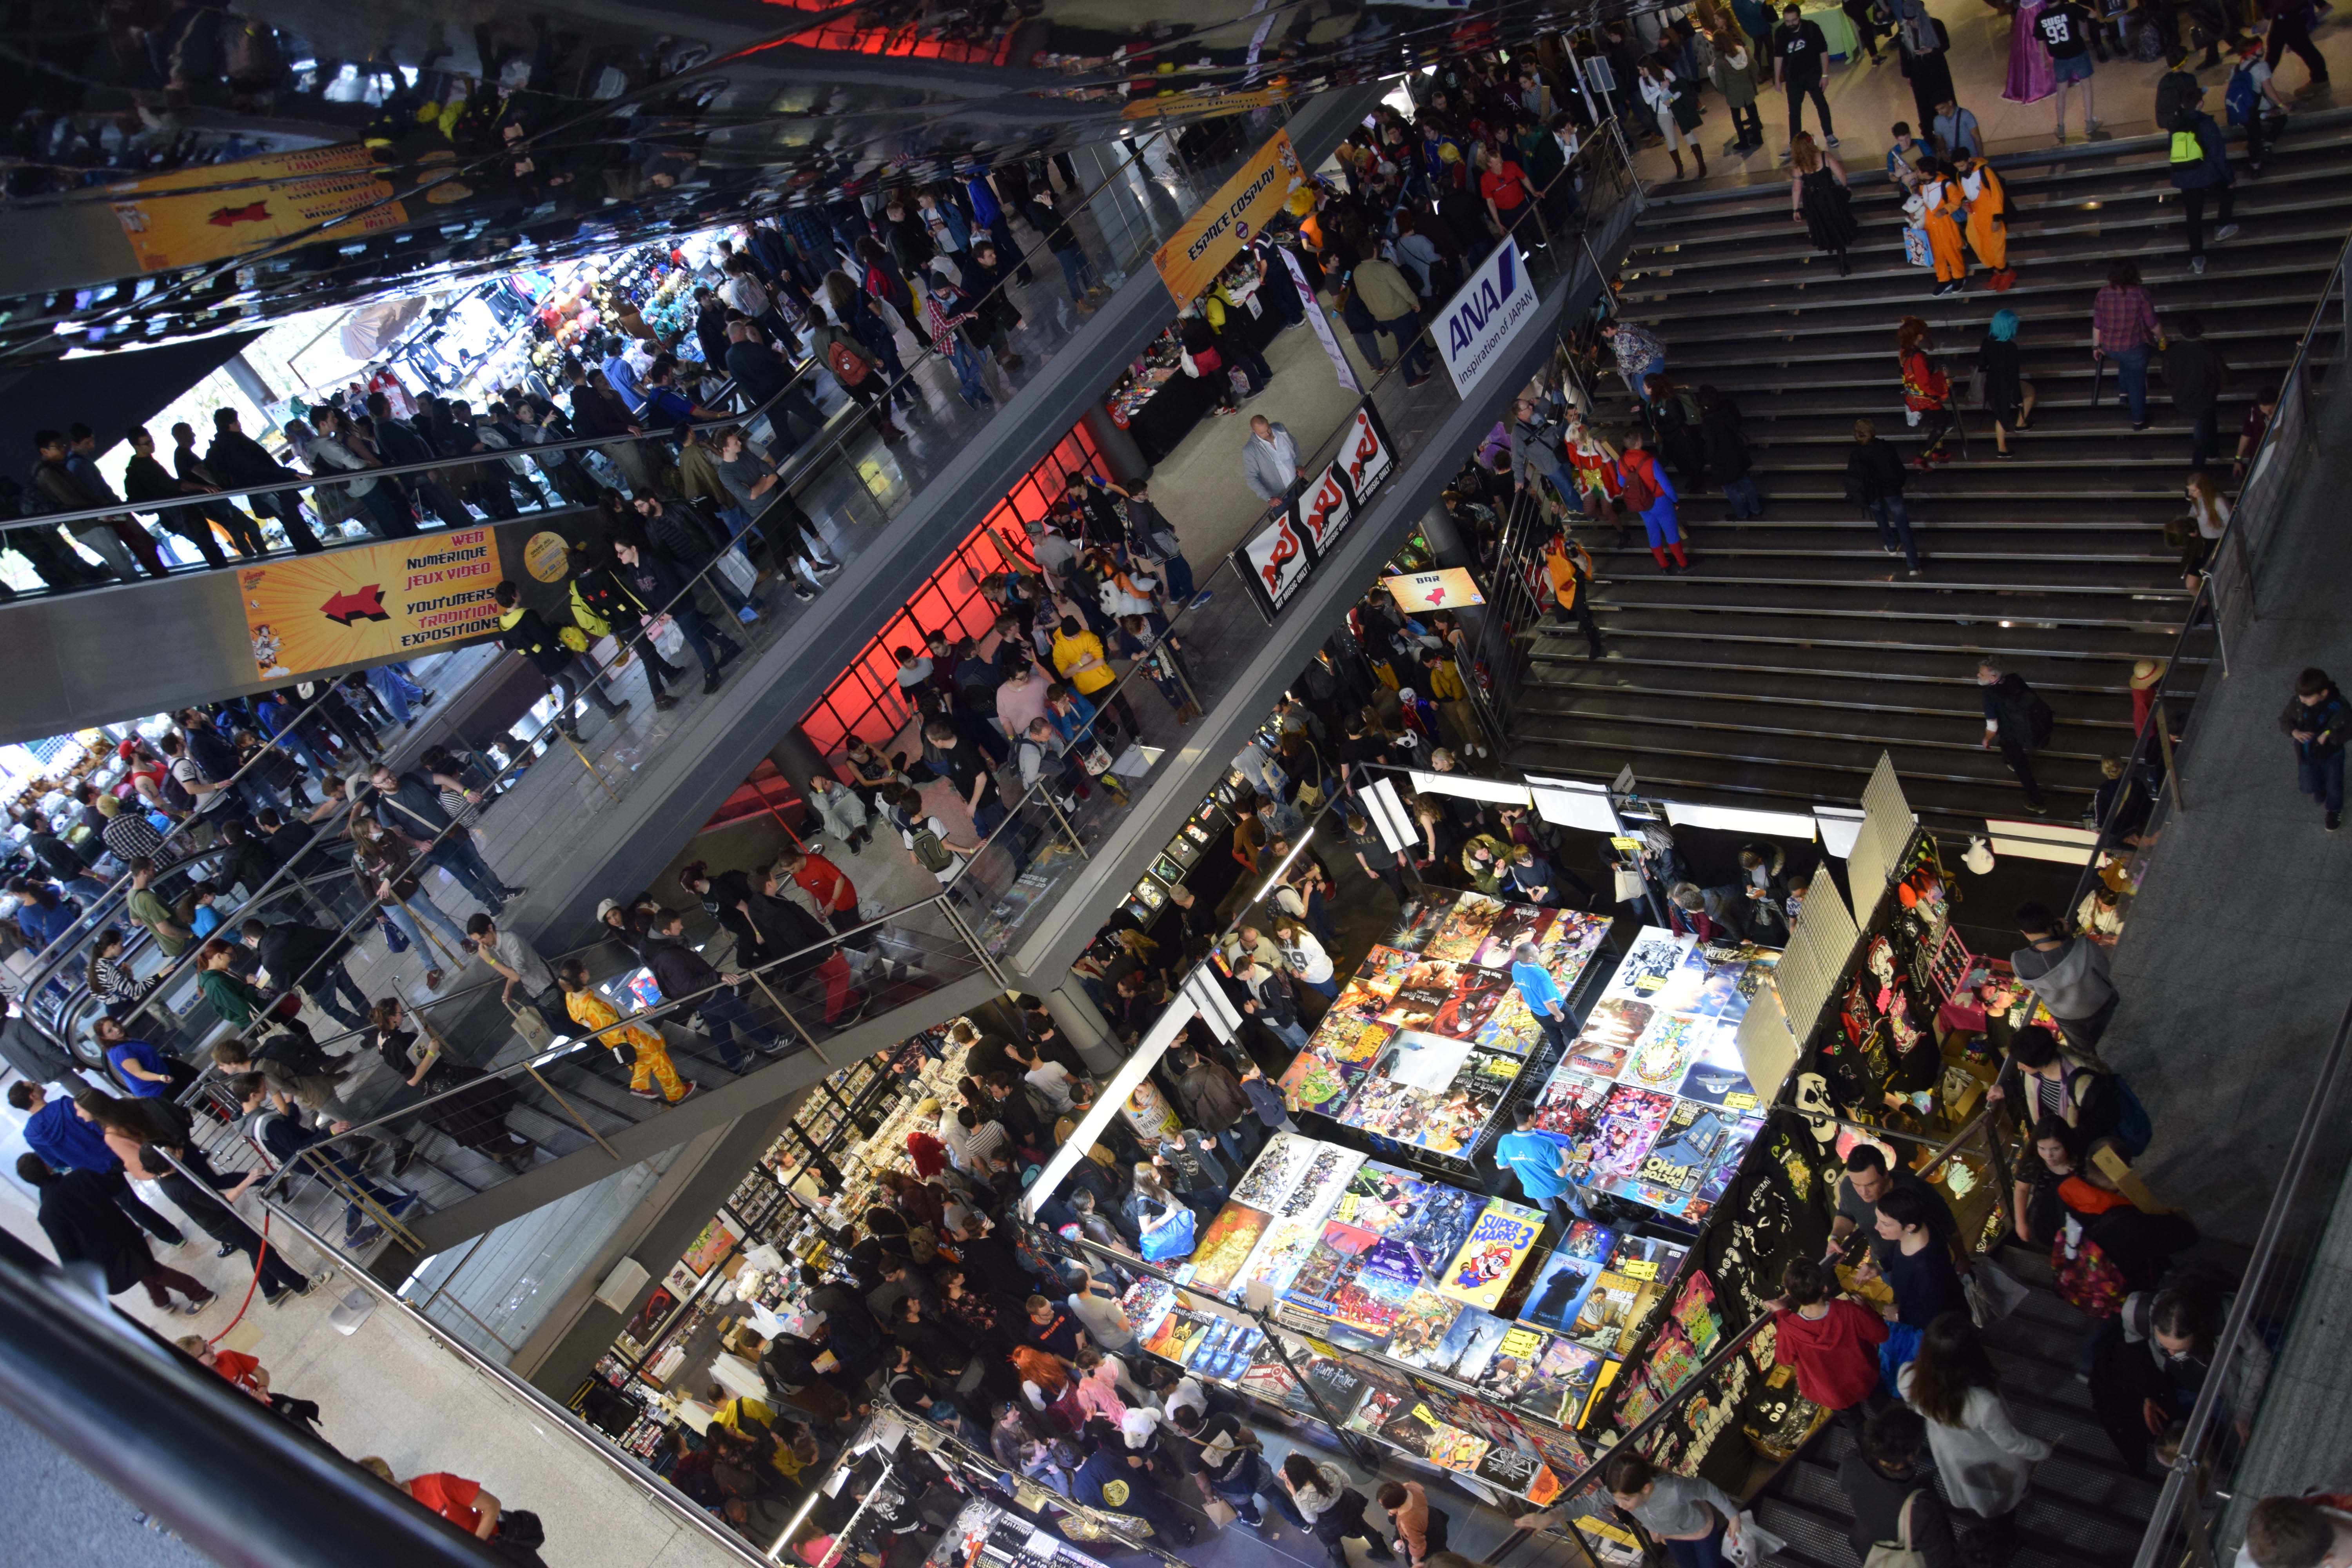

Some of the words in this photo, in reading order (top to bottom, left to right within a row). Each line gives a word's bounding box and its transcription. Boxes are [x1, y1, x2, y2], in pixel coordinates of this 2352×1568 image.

[2041, 14, 2068, 28] SUGA
[2045, 23, 2069, 44] 93
[1187, 212, 1230, 261] ESPACE
[1230, 165, 1275, 220] COSPLAY
[1449, 278, 1501, 361] ANA
[1458, 331, 1501, 384] Inspiration
[1501, 320, 1509, 335] of
[1509, 290, 1532, 325] JAPAN
[1350, 414, 1378, 492] NRJ
[1365, 478, 1379, 499] MUSIC
[1379, 465, 1390, 481] ONLY
[1307, 466, 1343, 544] NRJ
[452, 531, 484, 546] WEB
[1318, 545, 1326, 557] HIT
[1325, 530, 1339, 549] MUSIC
[1338, 518, 1349, 534] ONLY
[407, 546, 487, 570] NUMÉRIQUE
[1262, 516, 1299, 596] NRJ
[405, 572, 443, 591] JEUX
[448, 559, 490, 580] VIDÉO
[1416, 575, 1441, 584] BAR
[1276, 597, 1285, 610] HIT
[1283, 580, 1297, 601] MUSIC
[1296, 570, 1308, 587] ONLY
[407, 588, 495, 615] YOUTUBERS
[419, 603, 498, 629] TRADITION
[401, 616, 499, 646] EXPOSITIONS
[1705, 948, 1738, 962] ZELDA
[1401, 991, 1416, 1000] Titan
[1421, 995, 1441, 1006] Attack
[1572, 1054, 1616, 1073] DEADPOOL
[1348, 1071, 1366, 1087] Rick
[1455, 1077, 1475, 1088] Titan
[1481, 1081, 1504, 1096] Attack
[1591, 1110, 1600, 1121] Tokyo
[1599, 1096, 1610, 1111] Ghoul
[1681, 1110, 1695, 1120] TIME
[1647, 1158, 1688, 1180] WHO
[1642, 1170, 1683, 1189] DOCTOR
[1478, 1214, 1521, 1234] SUPER
[1469, 1228, 1516, 1244] MARIO
[1513, 1227, 1535, 1250] 3
[1376, 1267, 1409, 1281] MINECRAFT
[1288, 1293, 1333, 1310] MINECRAFT
[1609, 1288, 1638, 1300] BLOW
[648, 1321, 659, 1331] Tokyo
[657, 1310, 667, 1320] Ghoul
[1201, 1343, 1223, 1352] WINTER
[1249, 1367, 1271, 1378] GRIMES
[1314, 1361, 1334, 1382] Harry
[1330, 1368, 1358, 1388] Potter
[1263, 1379, 1278, 1388] TICKETS
